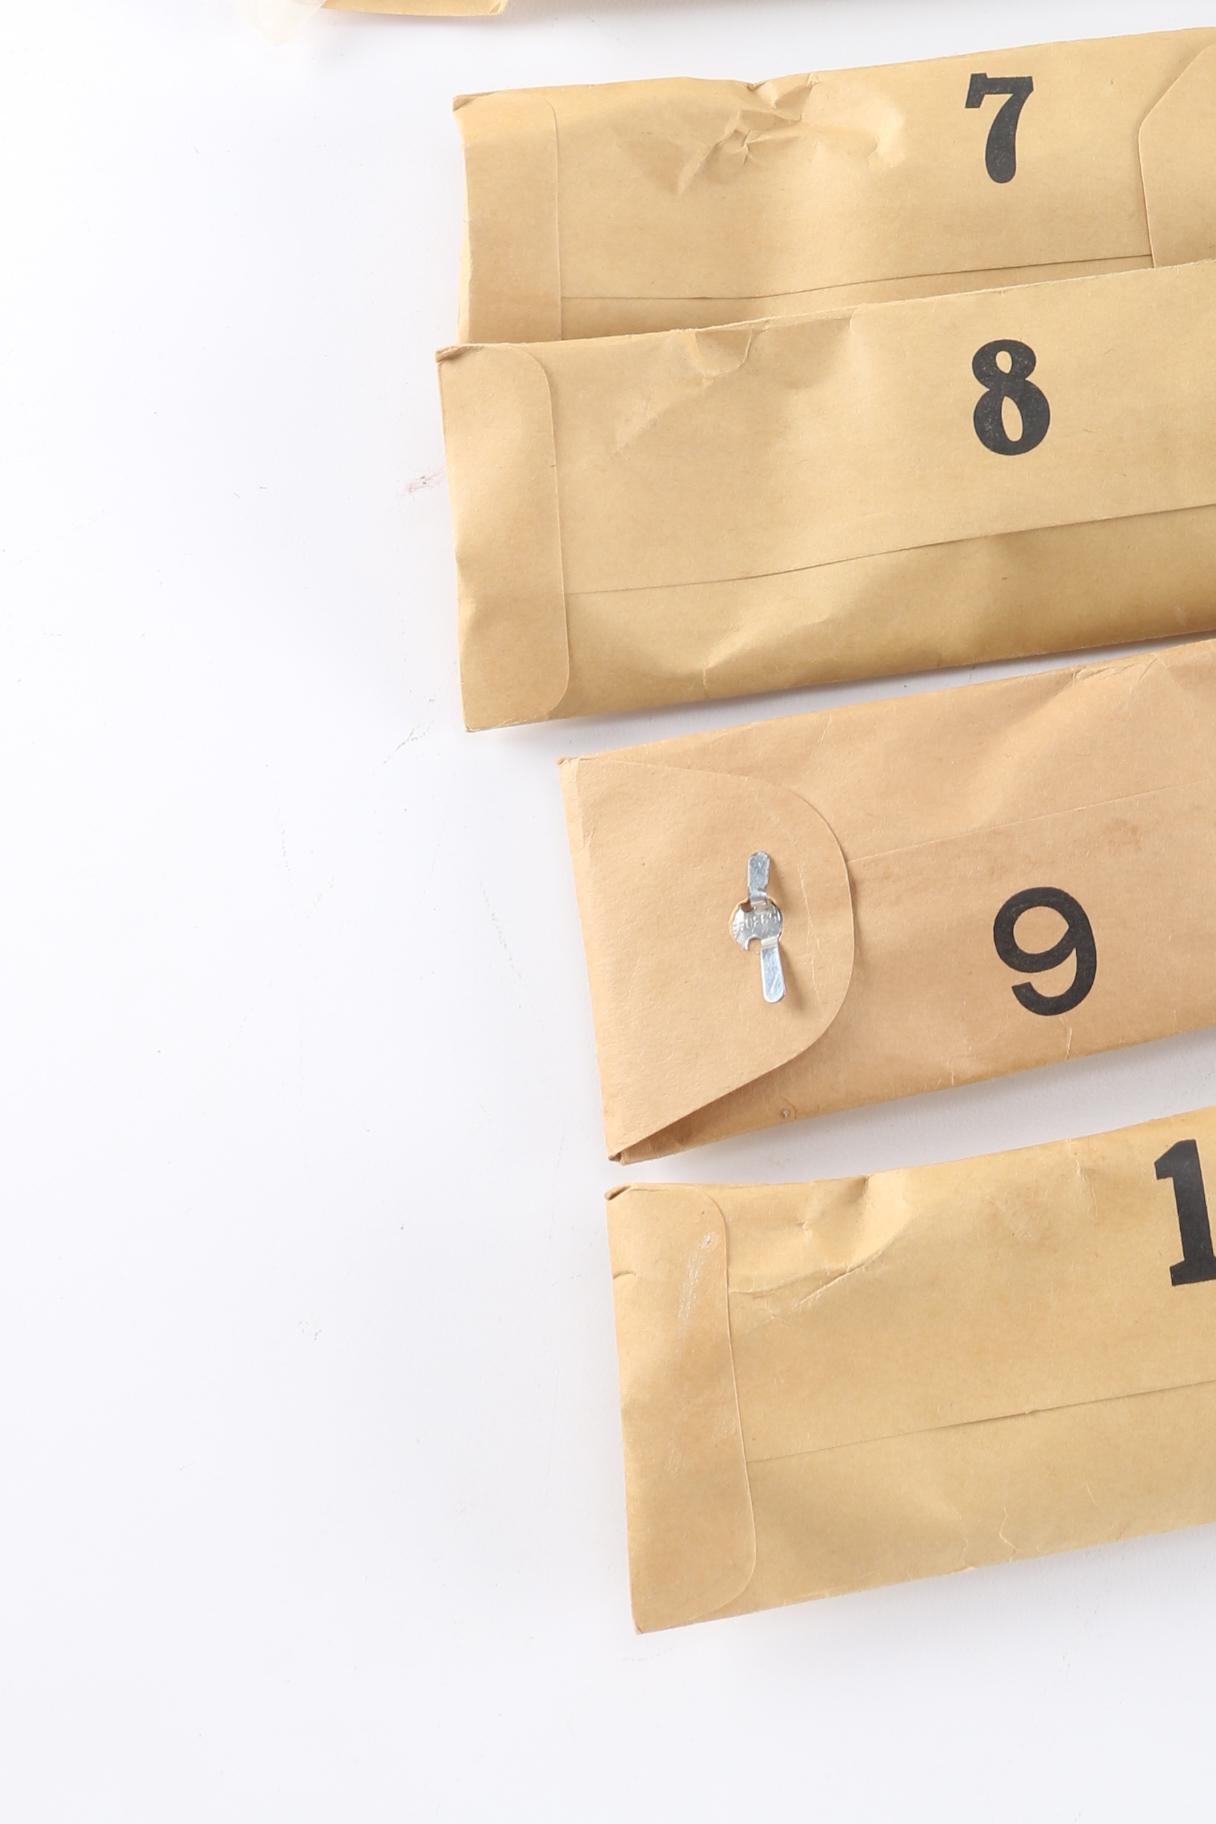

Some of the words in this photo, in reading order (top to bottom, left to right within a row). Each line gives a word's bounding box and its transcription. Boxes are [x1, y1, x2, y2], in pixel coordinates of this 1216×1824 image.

[965, 73, 1034, 184] 7
[971, 339, 1051, 456] 8
[992, 886, 1098, 1017] 9
